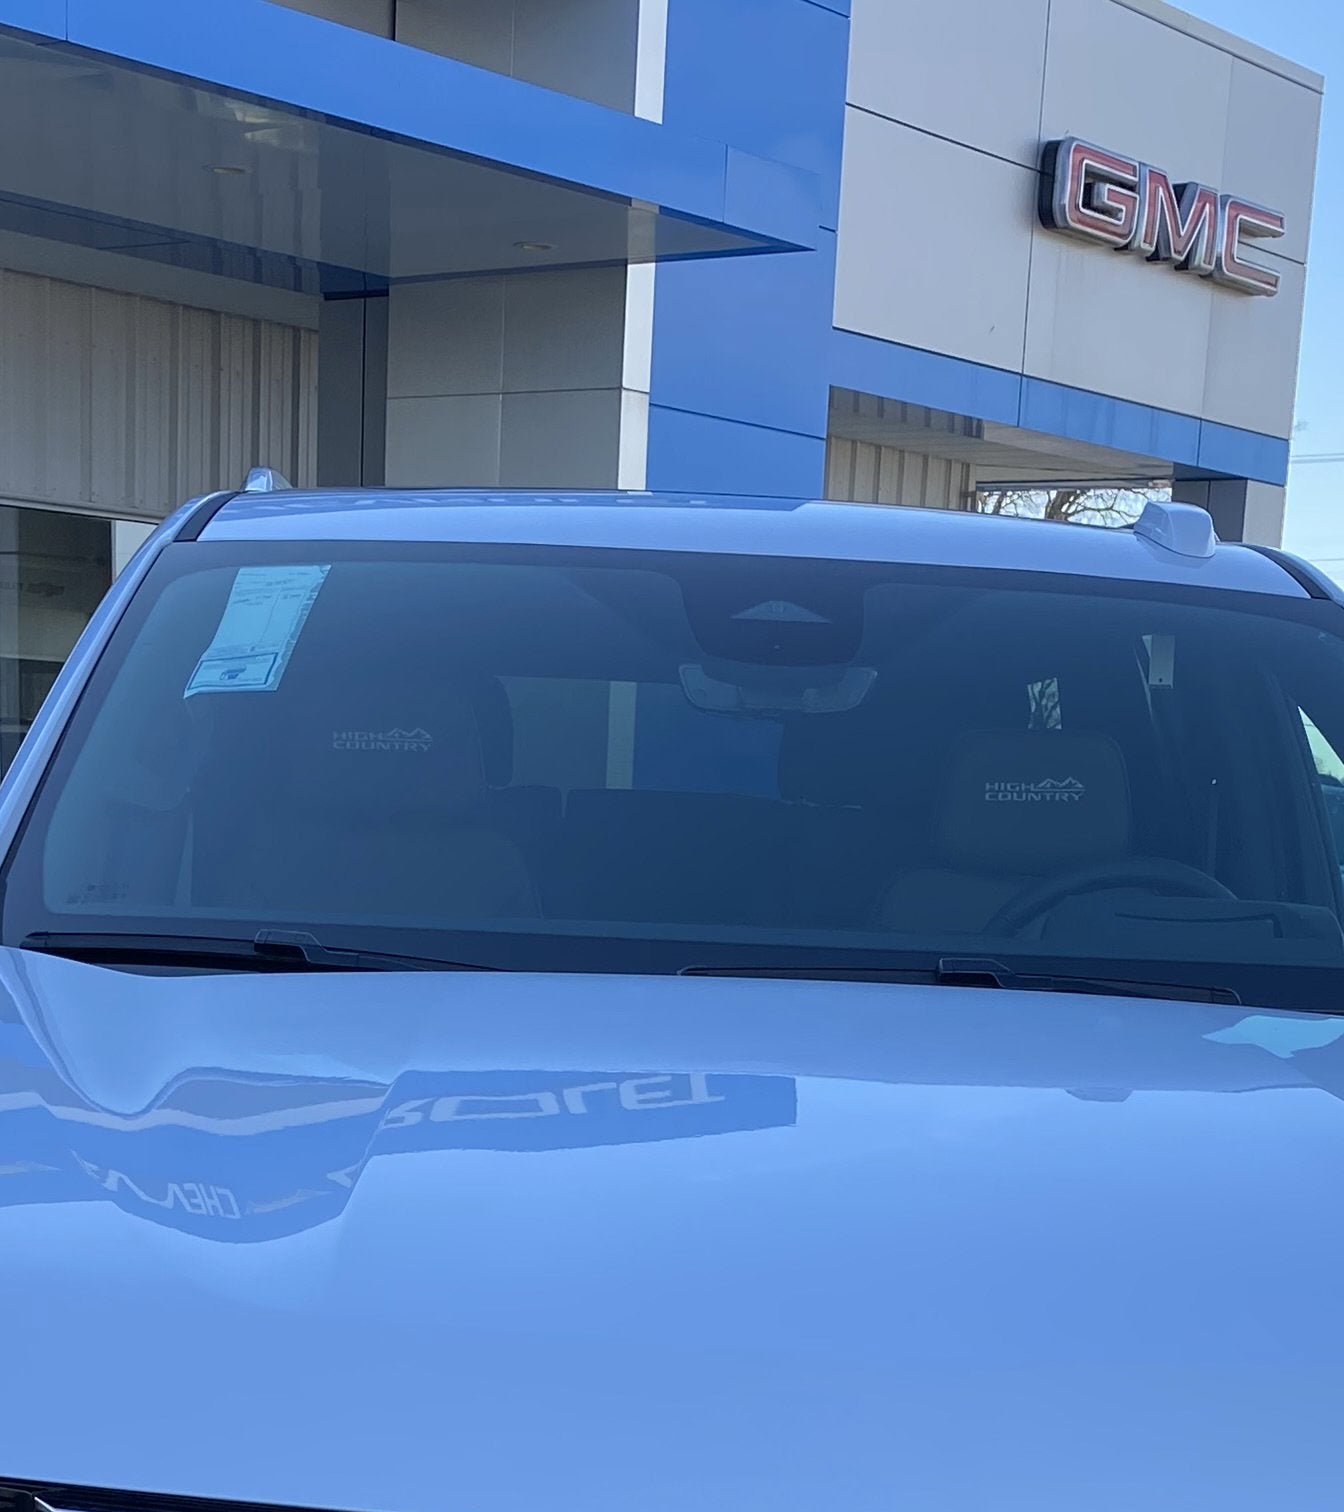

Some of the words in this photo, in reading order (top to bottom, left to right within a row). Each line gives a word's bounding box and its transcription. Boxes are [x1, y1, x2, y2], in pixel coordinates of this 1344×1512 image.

[1054, 138, 1285, 297] GMC
[332, 741, 432, 752] COUNTRY
[984, 782, 1035, 791] HIGH
[984, 792, 1084, 802] COUNTRY
